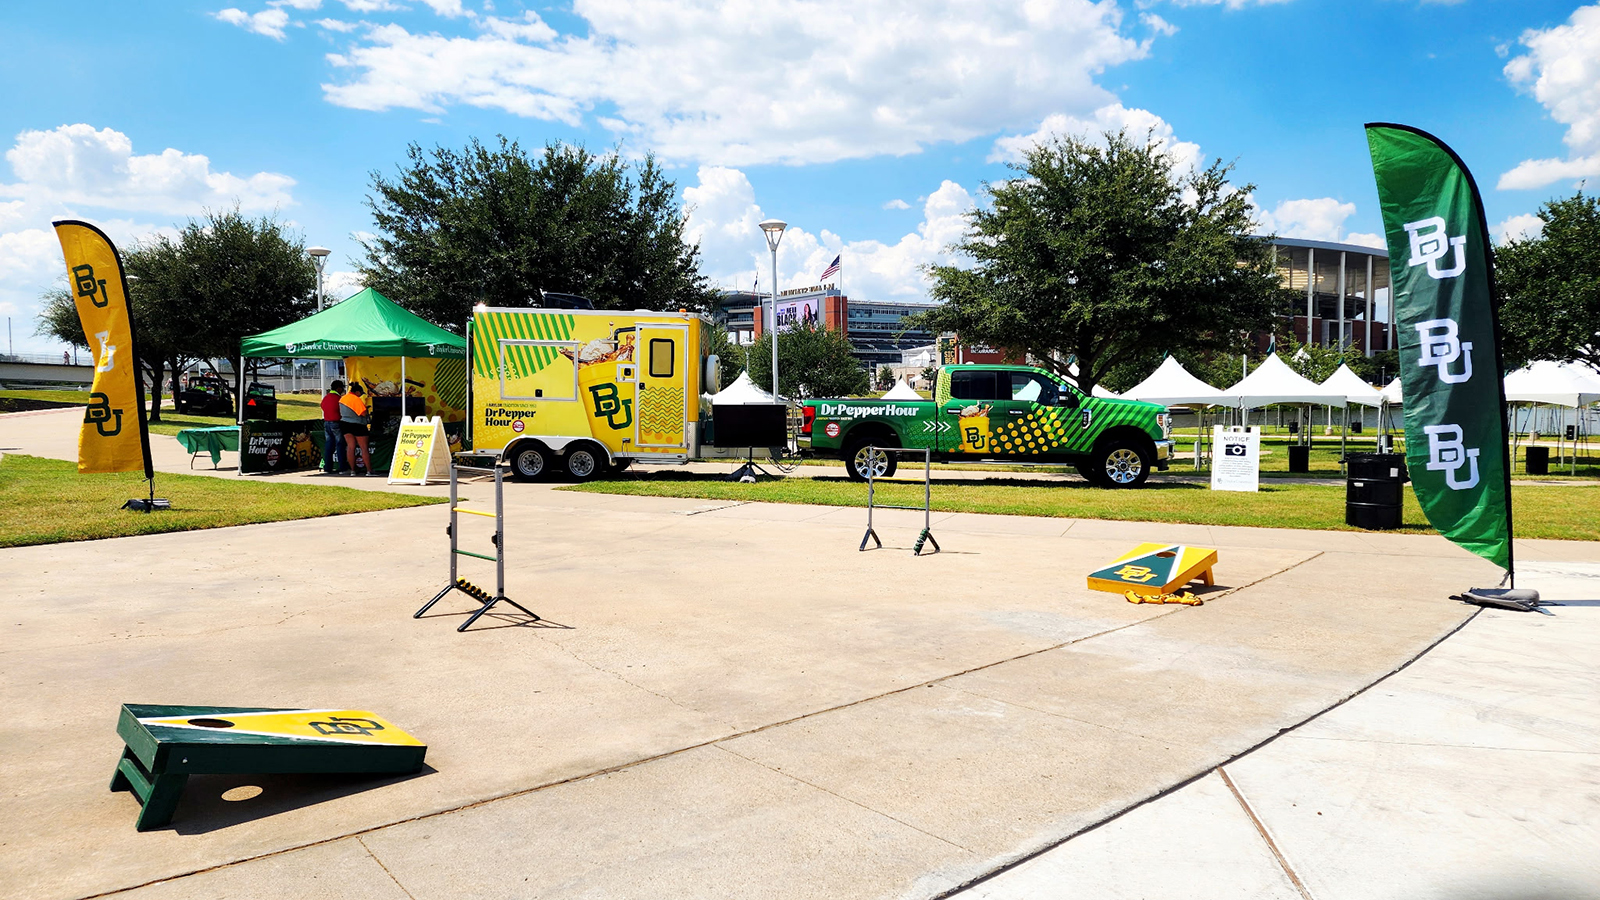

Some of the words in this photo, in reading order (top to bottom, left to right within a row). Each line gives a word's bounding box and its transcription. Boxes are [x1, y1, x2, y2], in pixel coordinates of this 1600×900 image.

[1404, 216, 1466, 279] BU
[72, 264, 109, 308] BU
[300, 342, 322, 352] Baylor
[322, 341, 358, 352] University
[1415, 318, 1473, 383] BU
[84, 392, 124, 436] BU
[485, 417, 511, 426] Hour
[588, 382, 633, 430] BU
[248, 446, 268, 454] Hour
[965, 427, 985, 449] BU
[401, 461, 411, 476] BU
[1424, 424, 1480, 490] BU
[1113, 564, 1158, 582] BU
